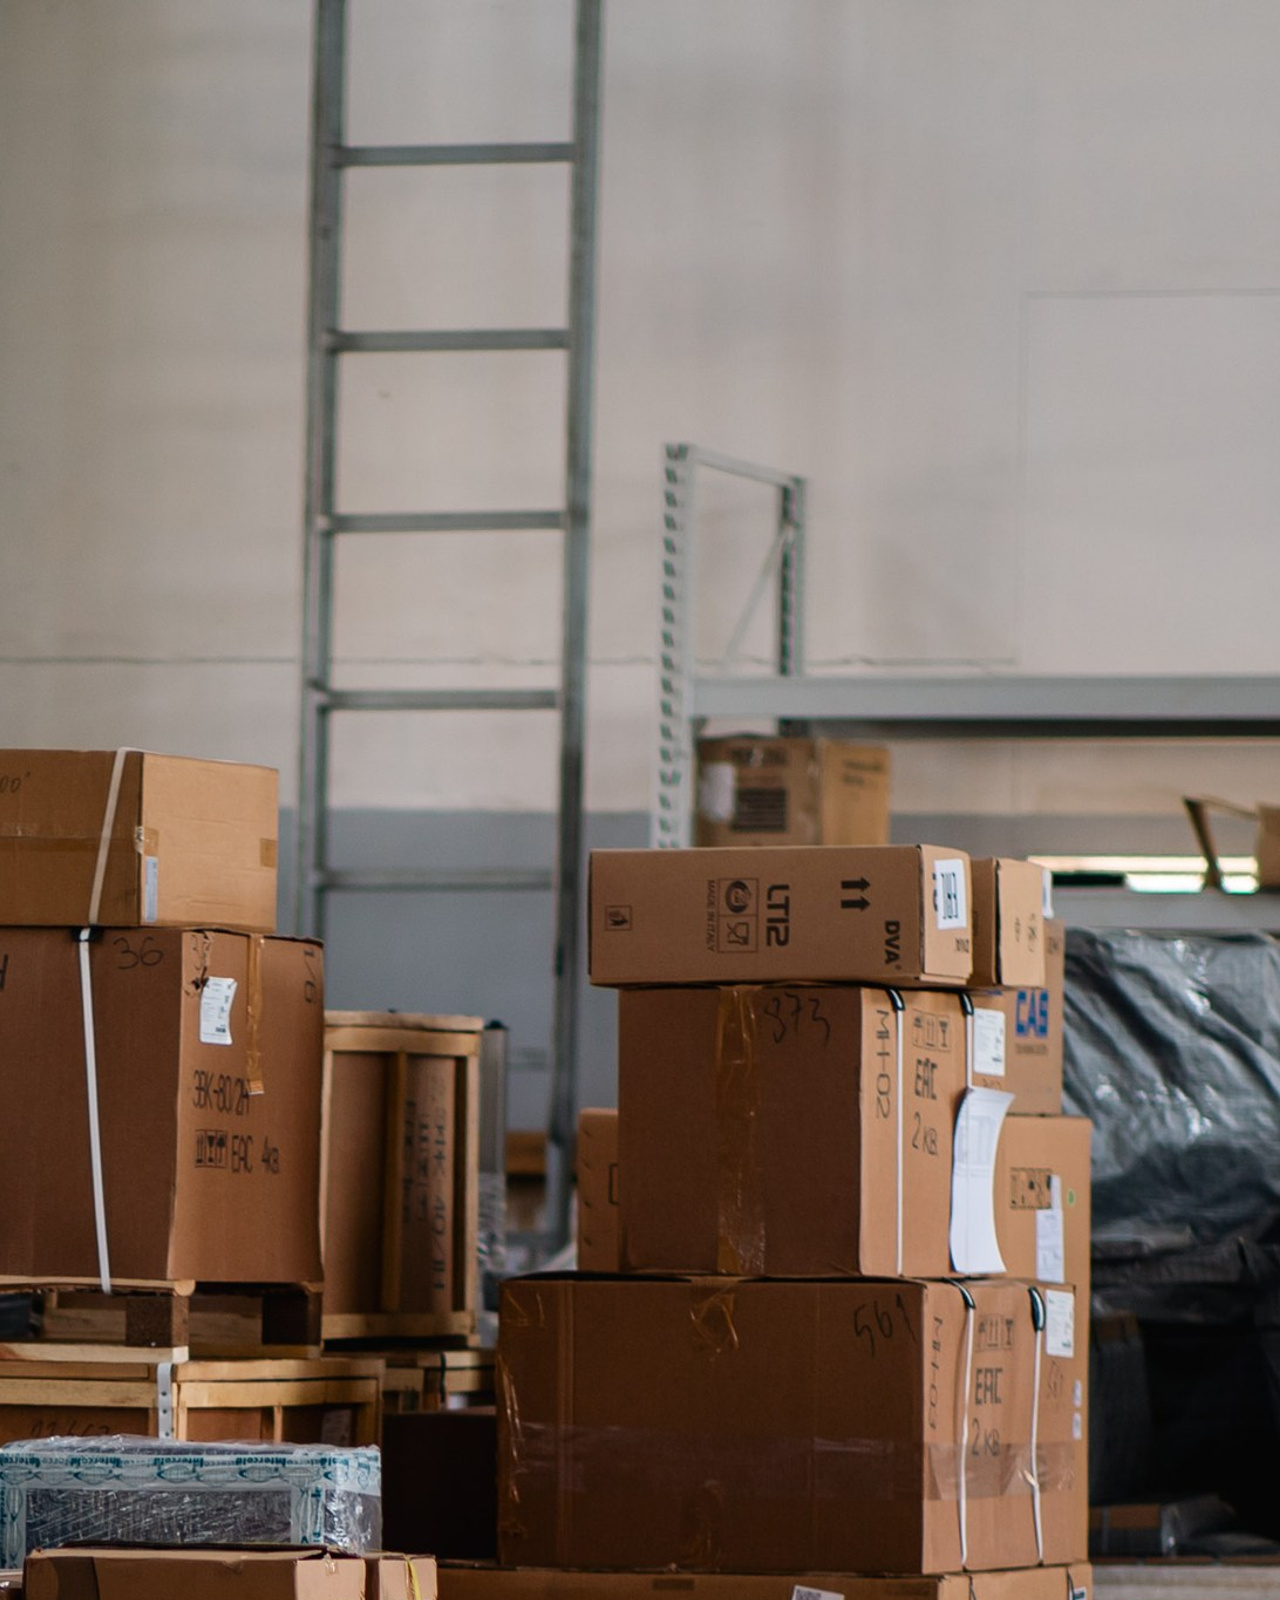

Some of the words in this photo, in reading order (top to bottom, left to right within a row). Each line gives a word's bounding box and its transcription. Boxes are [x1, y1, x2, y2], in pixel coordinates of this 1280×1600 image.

[113, 936, 164, 970] 36
[884, 920, 901, 966] DVA
[1015, 990, 1049, 1038] CAS
[975, 1367, 1004, 1406] EAC
